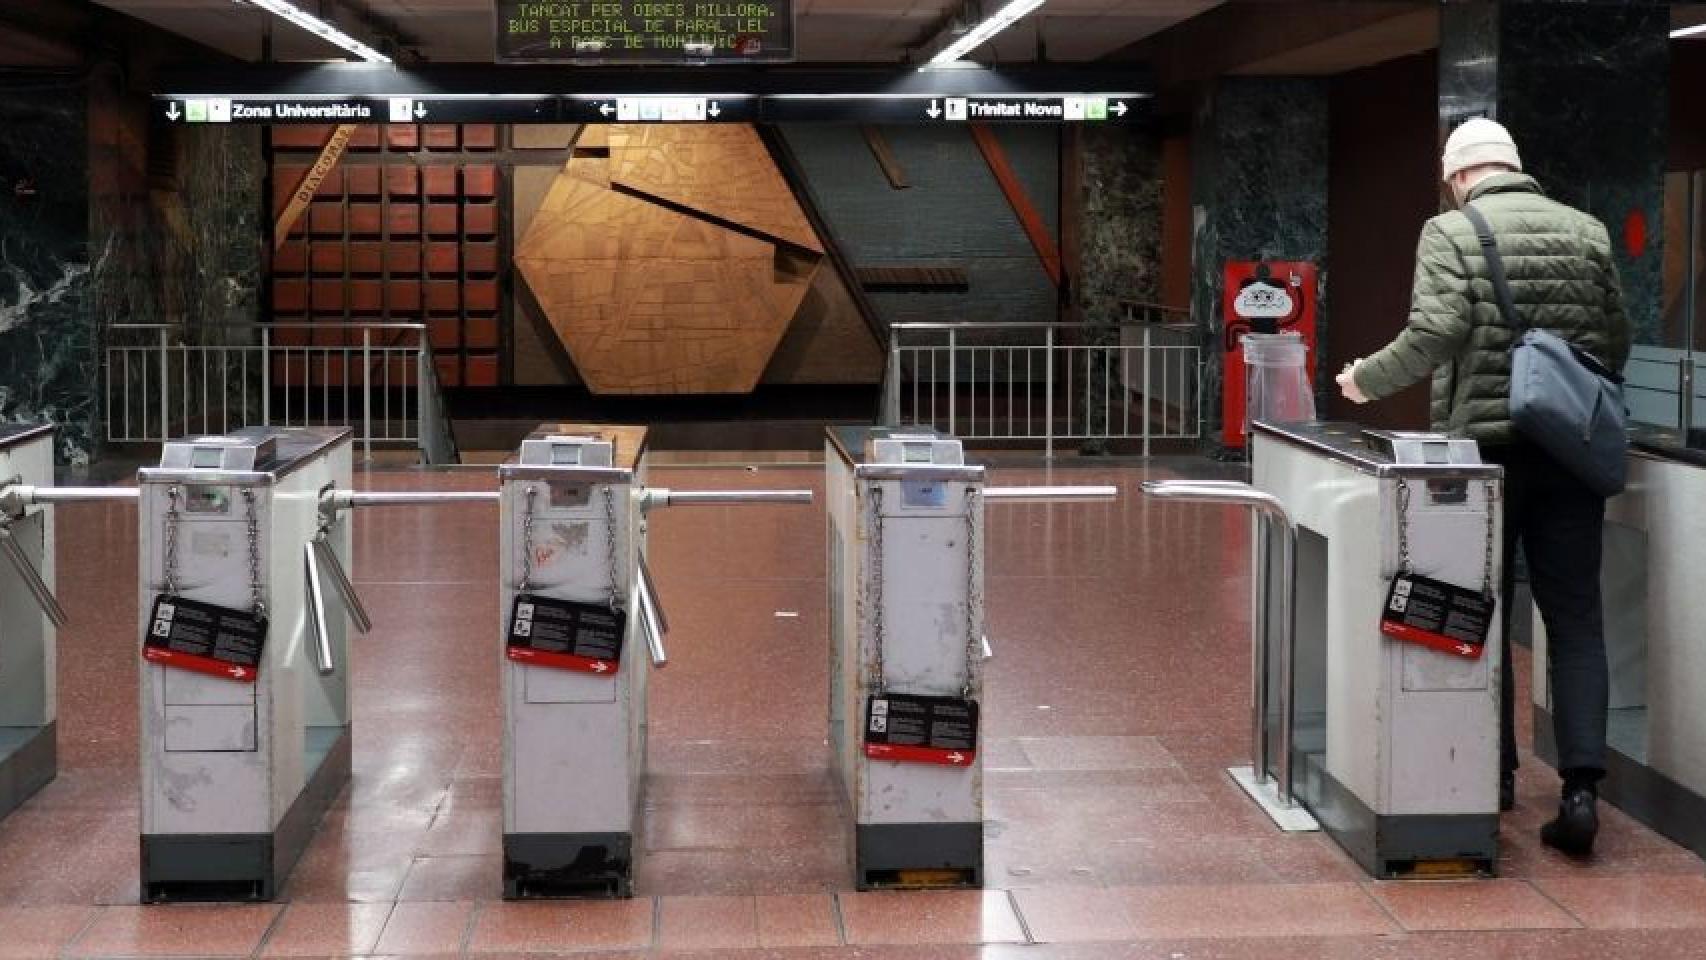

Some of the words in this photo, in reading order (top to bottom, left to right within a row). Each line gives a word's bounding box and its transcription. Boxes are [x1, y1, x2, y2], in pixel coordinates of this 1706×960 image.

[518, 3, 580, 17] TANCAT
[591, 3, 623, 17] PER
[508, 19, 539, 33] BUS
[549, 19, 633, 33] ESPECIAL
[643, 19, 665, 33] DE
[232, 103, 273, 118] Zona
[968, 102, 1021, 117] Trinitat
[1024, 102, 1063, 117] Nova
